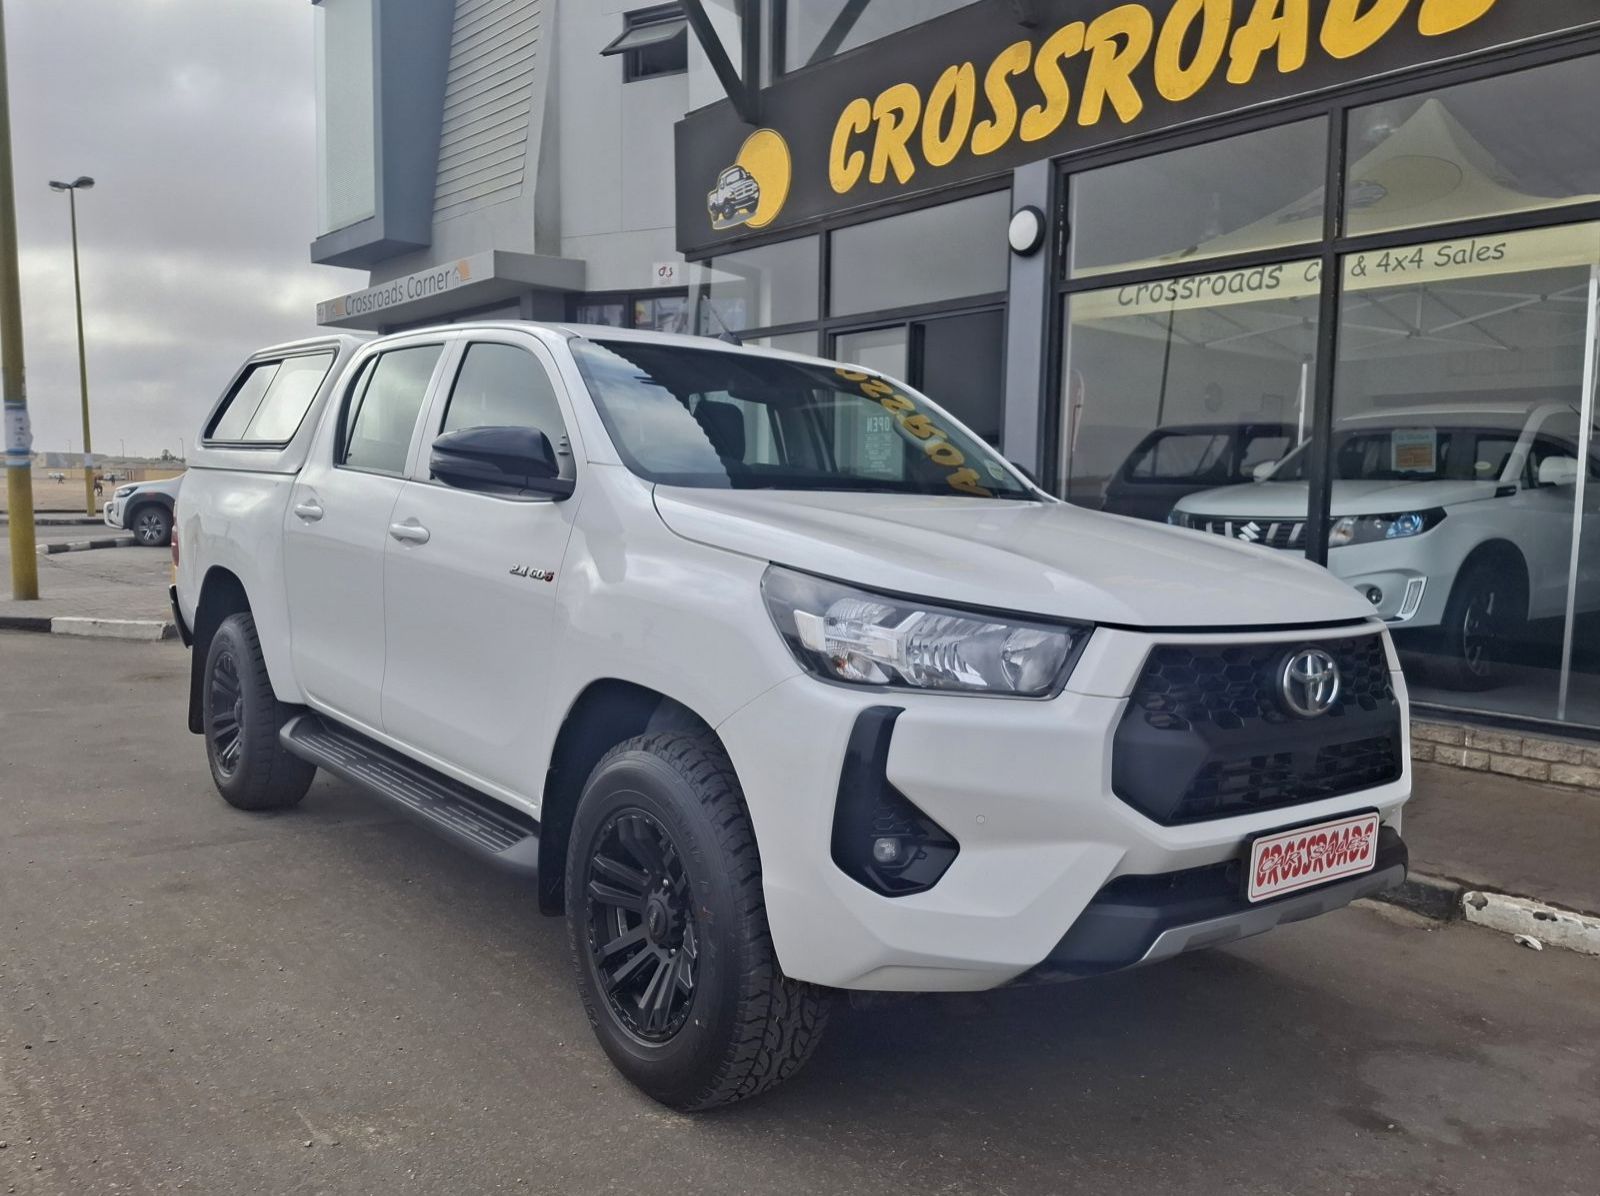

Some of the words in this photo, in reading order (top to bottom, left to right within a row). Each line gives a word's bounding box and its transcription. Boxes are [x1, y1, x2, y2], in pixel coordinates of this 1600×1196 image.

[344, 281, 403, 316] Crossroads
[407, 269, 451, 299] Corner
[1117, 264, 1283, 307] Crossroads
[1351, 255, 1368, 278] &
[1376, 246, 1425, 275] 4x4
[1434, 239, 1507, 268] Sales
[1256, 822, 1374, 888] CROSSROADS
